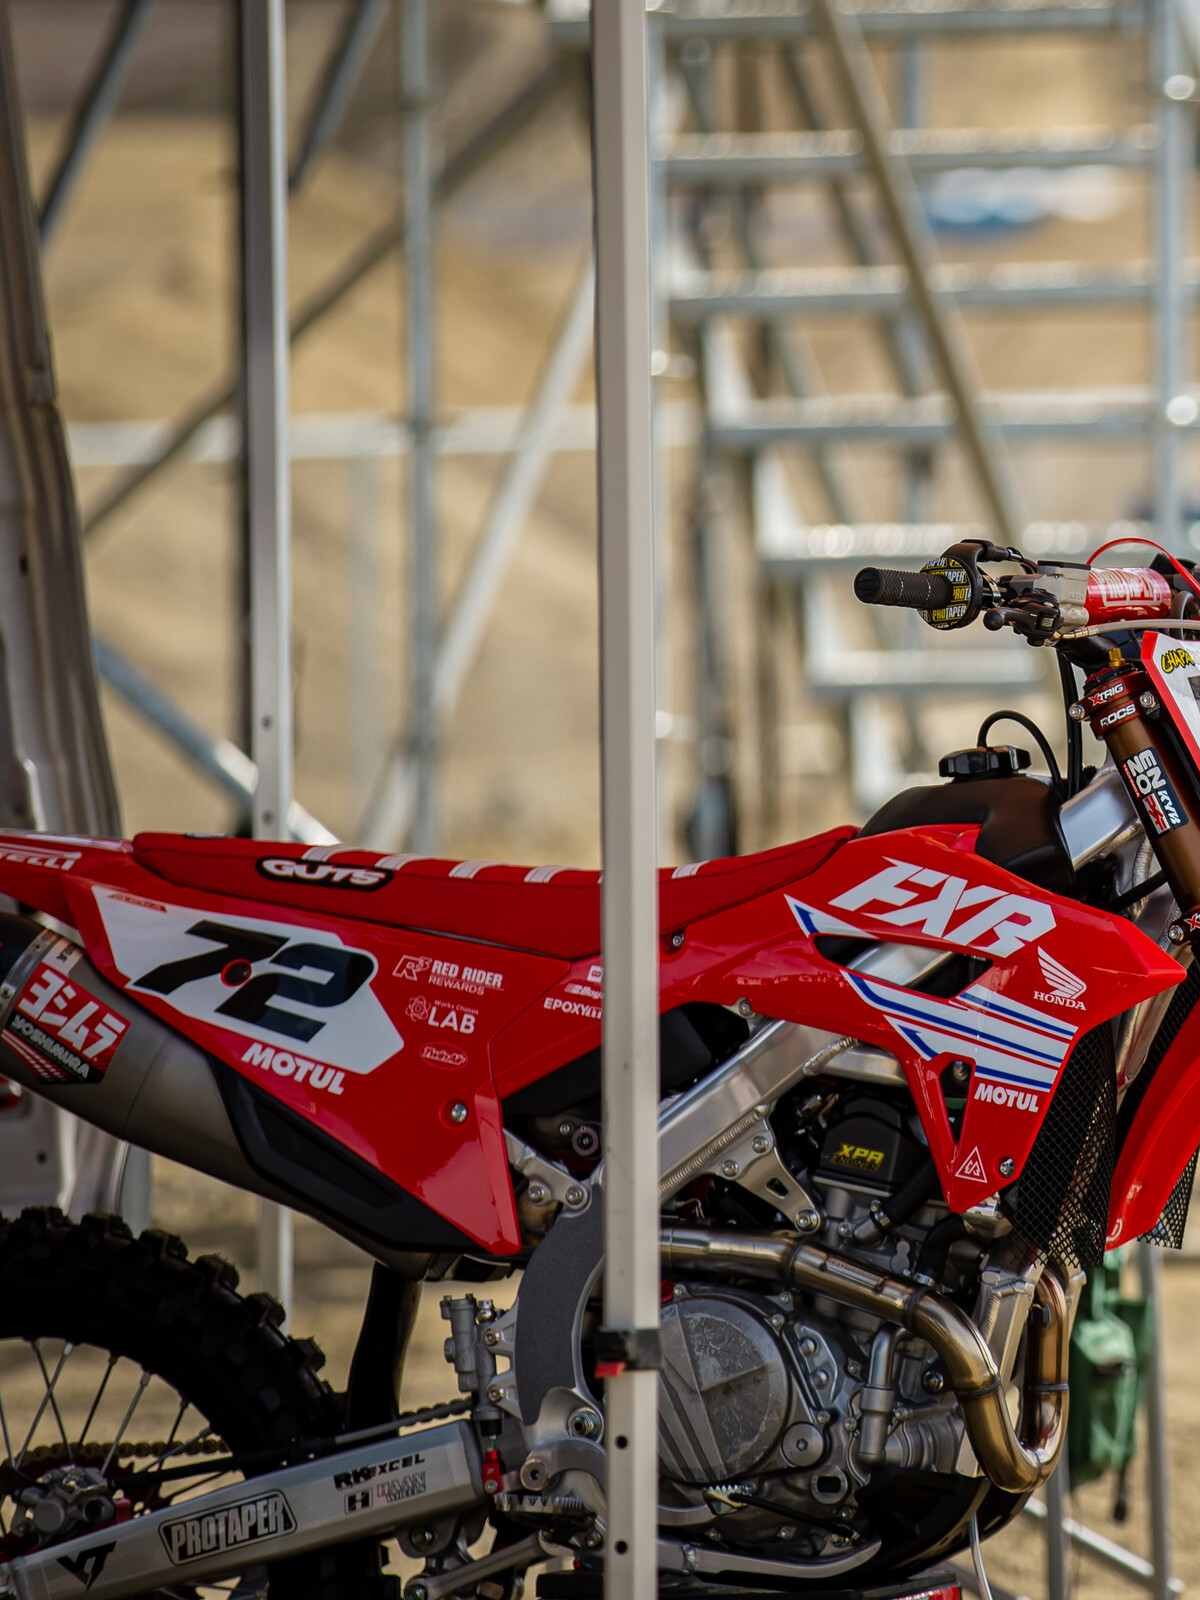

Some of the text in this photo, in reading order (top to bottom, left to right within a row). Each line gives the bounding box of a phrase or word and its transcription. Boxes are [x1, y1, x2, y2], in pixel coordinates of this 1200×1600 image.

[1088, 682, 1125, 707] XTRIG
[1100, 703, 1136, 727] ROCS
[1157, 790, 1182, 825] KYB
[262, 859, 386, 886] GUTS
[828, 856, 1057, 958] FXR
[132, 919, 375, 1043] 72
[428, 975, 485, 996] REWARDS
[431, 960, 503, 988] RED RIDER
[18, 969, 126, 1059] ヨシムラ
[1033, 990, 1087, 1011] HONDA
[428, 1006, 476, 1034] LAB
[11, 1014, 90, 1080] YOSHIMURA
[241, 1042, 345, 1096] MOTUL
[974, 1083, 1040, 1113] MOTUL
[170, 1498, 286, 1565] PROTAPER
